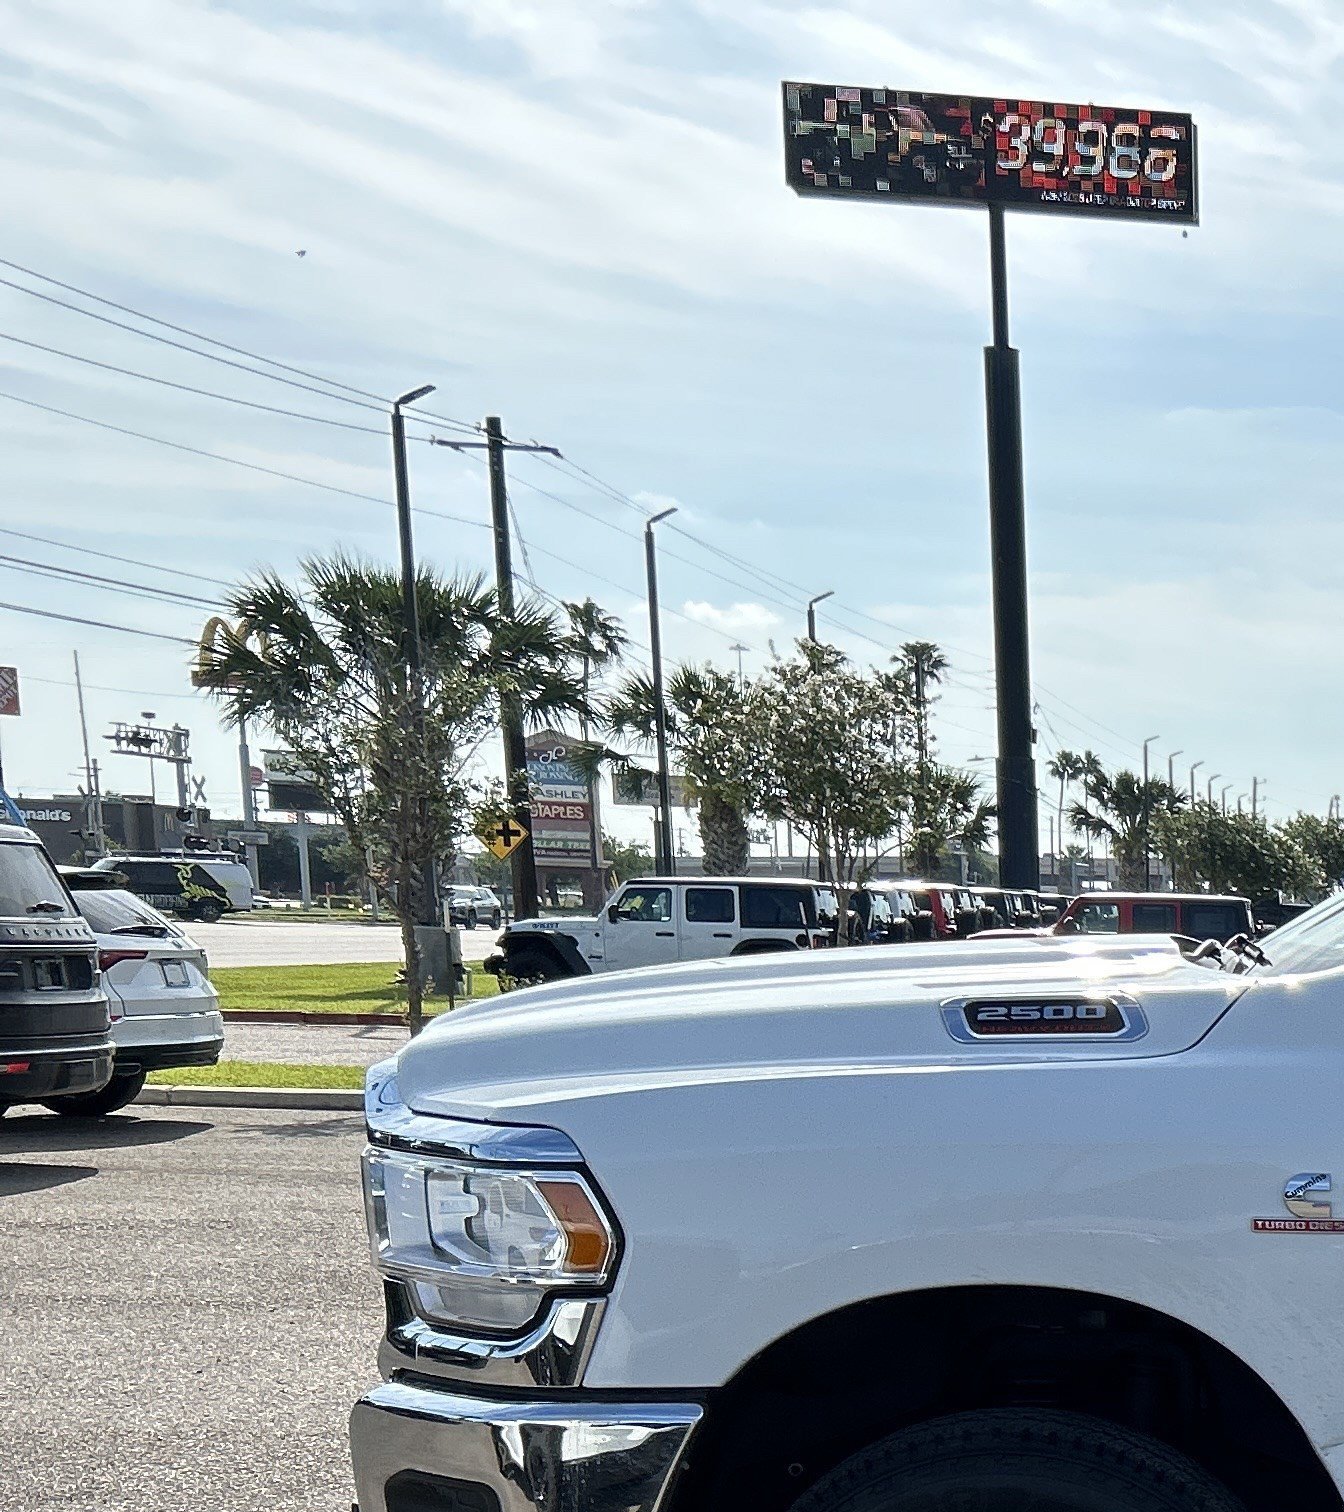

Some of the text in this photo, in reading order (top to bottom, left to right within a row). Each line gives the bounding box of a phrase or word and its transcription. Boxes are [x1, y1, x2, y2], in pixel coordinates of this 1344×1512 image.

[530, 803, 584, 819] STAPLES
[976, 1004, 1106, 1021] 2500
[1284, 1173, 1327, 1199] Cummins
[1255, 1219, 1306, 1231] TURBO
